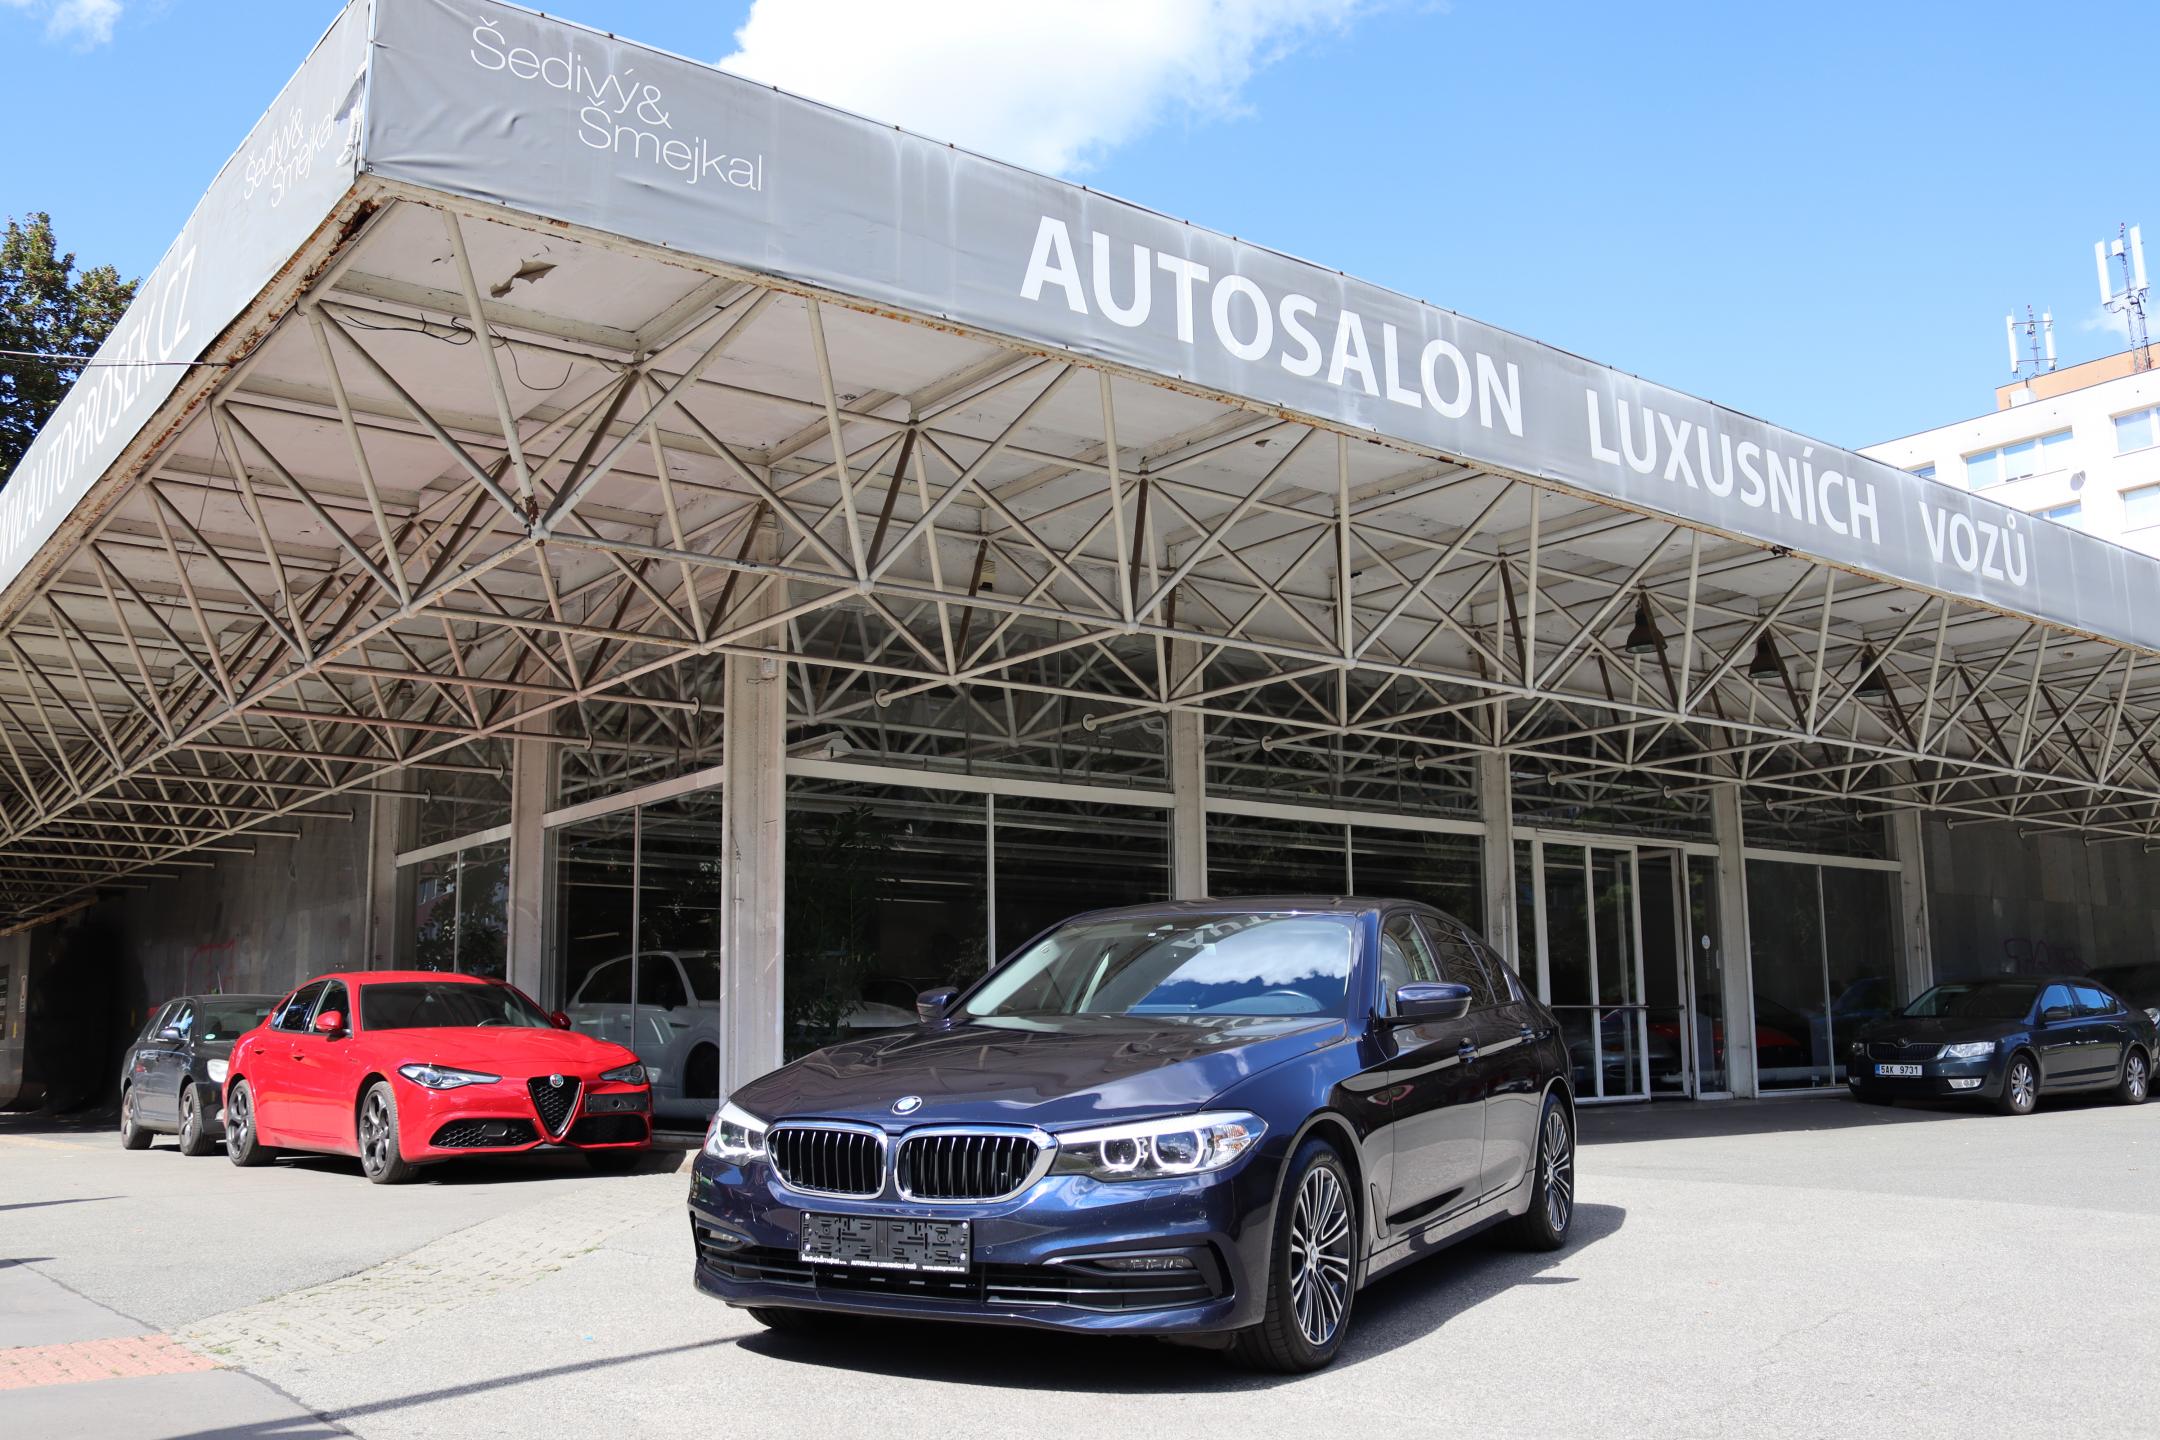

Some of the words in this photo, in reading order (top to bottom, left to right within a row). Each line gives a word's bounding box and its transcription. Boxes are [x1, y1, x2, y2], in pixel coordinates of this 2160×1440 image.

[470, 15, 673, 130] Šedivý&
[271, 96, 336, 208] Šmejkal
[578, 95, 763, 192] Šmejkal
[1019, 215, 1524, 439] AUTOSALON
[1585, 388, 1881, 545] LUXUSNÍCH
[1918, 500, 2029, 587] VOZŮ
[1880, 1065, 1894, 1075] 5AK
[1899, 1065, 1918, 1075] 9731
